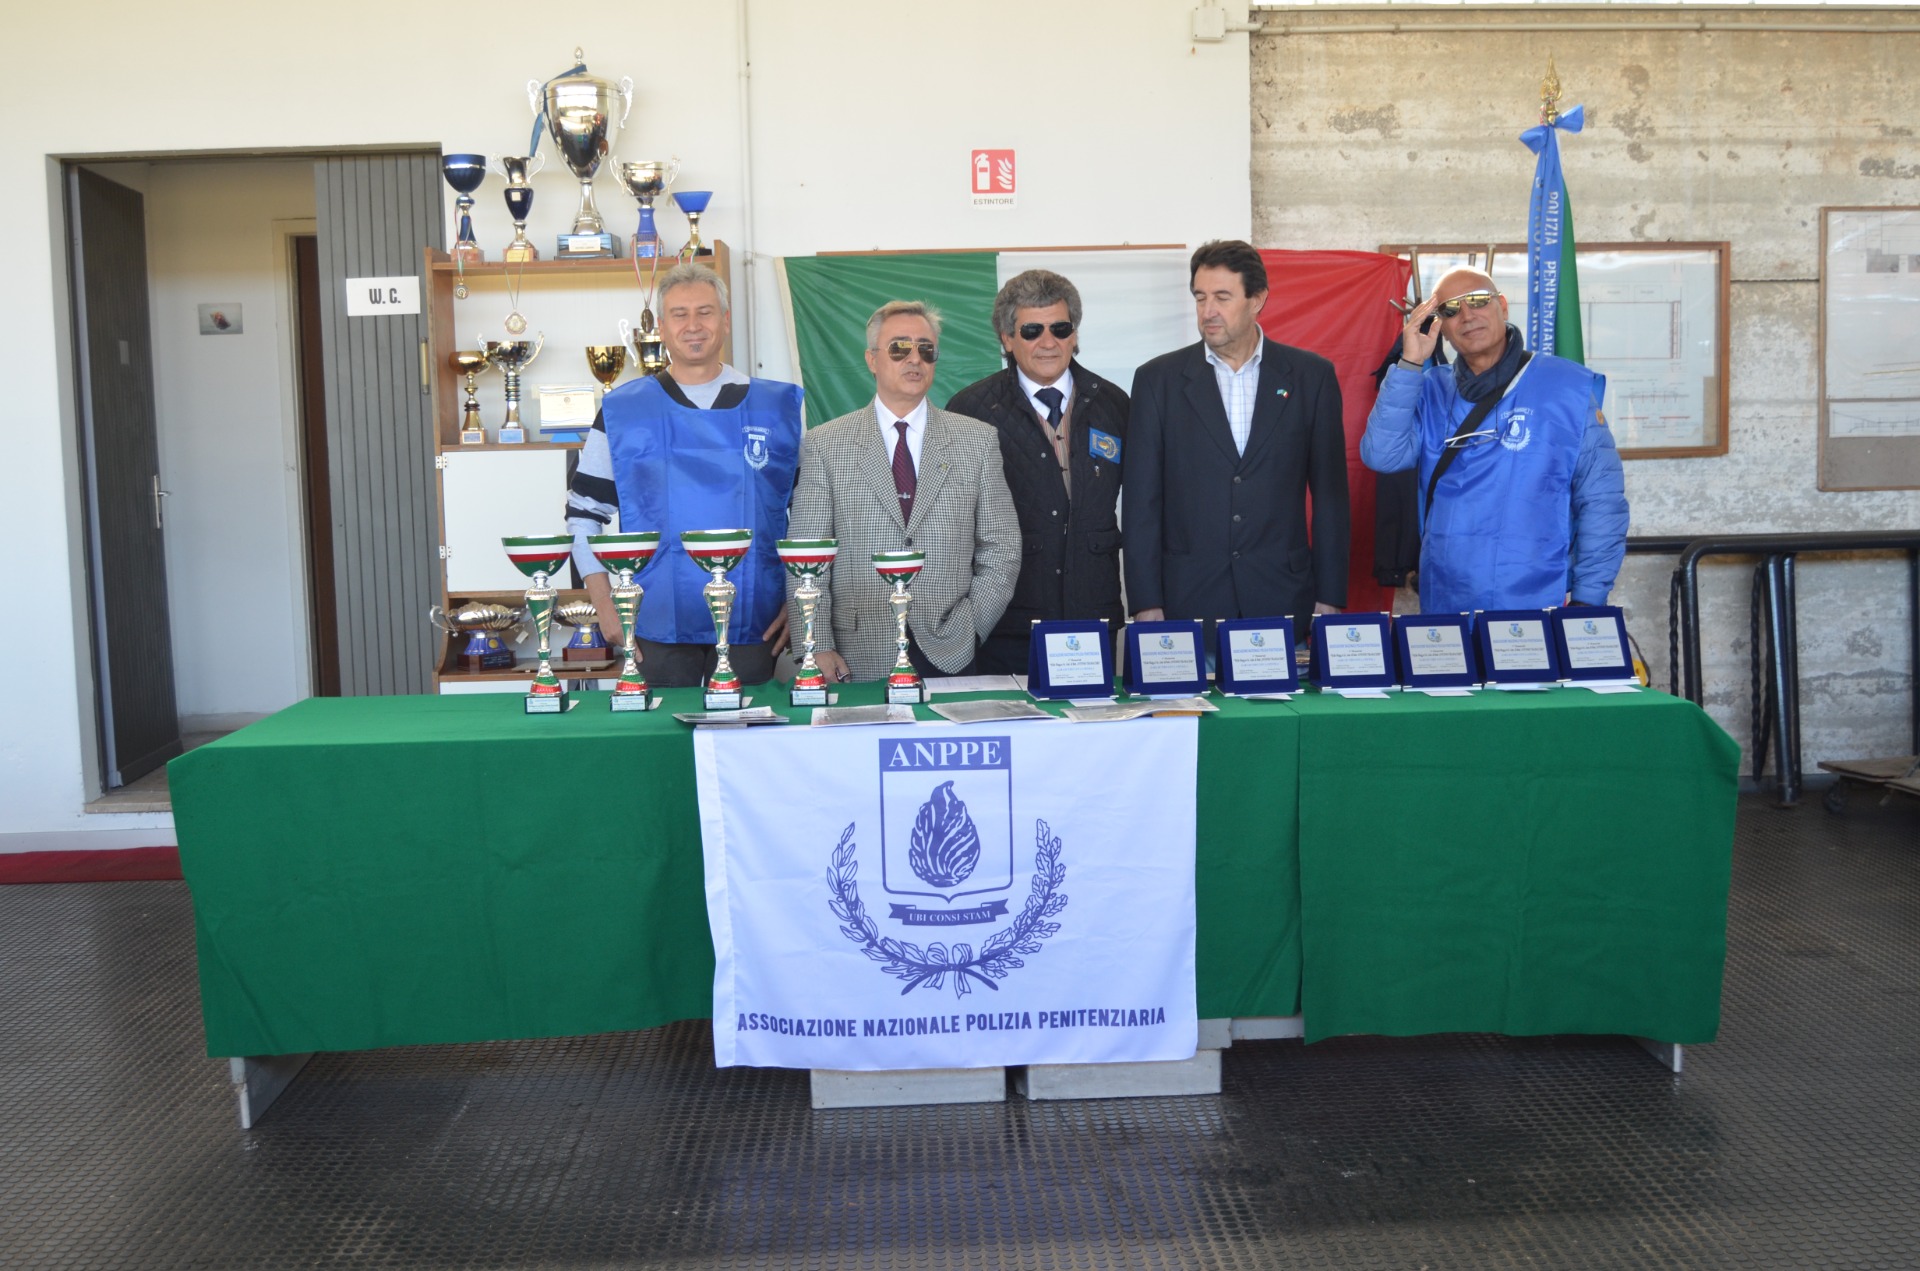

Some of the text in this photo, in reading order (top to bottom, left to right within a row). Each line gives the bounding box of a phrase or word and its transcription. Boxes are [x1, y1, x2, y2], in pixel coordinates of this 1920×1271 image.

[1541, 191, 1560, 357] POLIZIA PENITENZIARI
[368, 287, 401, 304] W. C.
[888, 741, 1002, 767] ANPPE
[909, 913, 926, 922] UBI
[963, 910, 991, 920] STAM
[737, 1007, 1166, 1037] ASSOCIAZIONE NAZIONALE POLIZIA PENITENZIARIA
